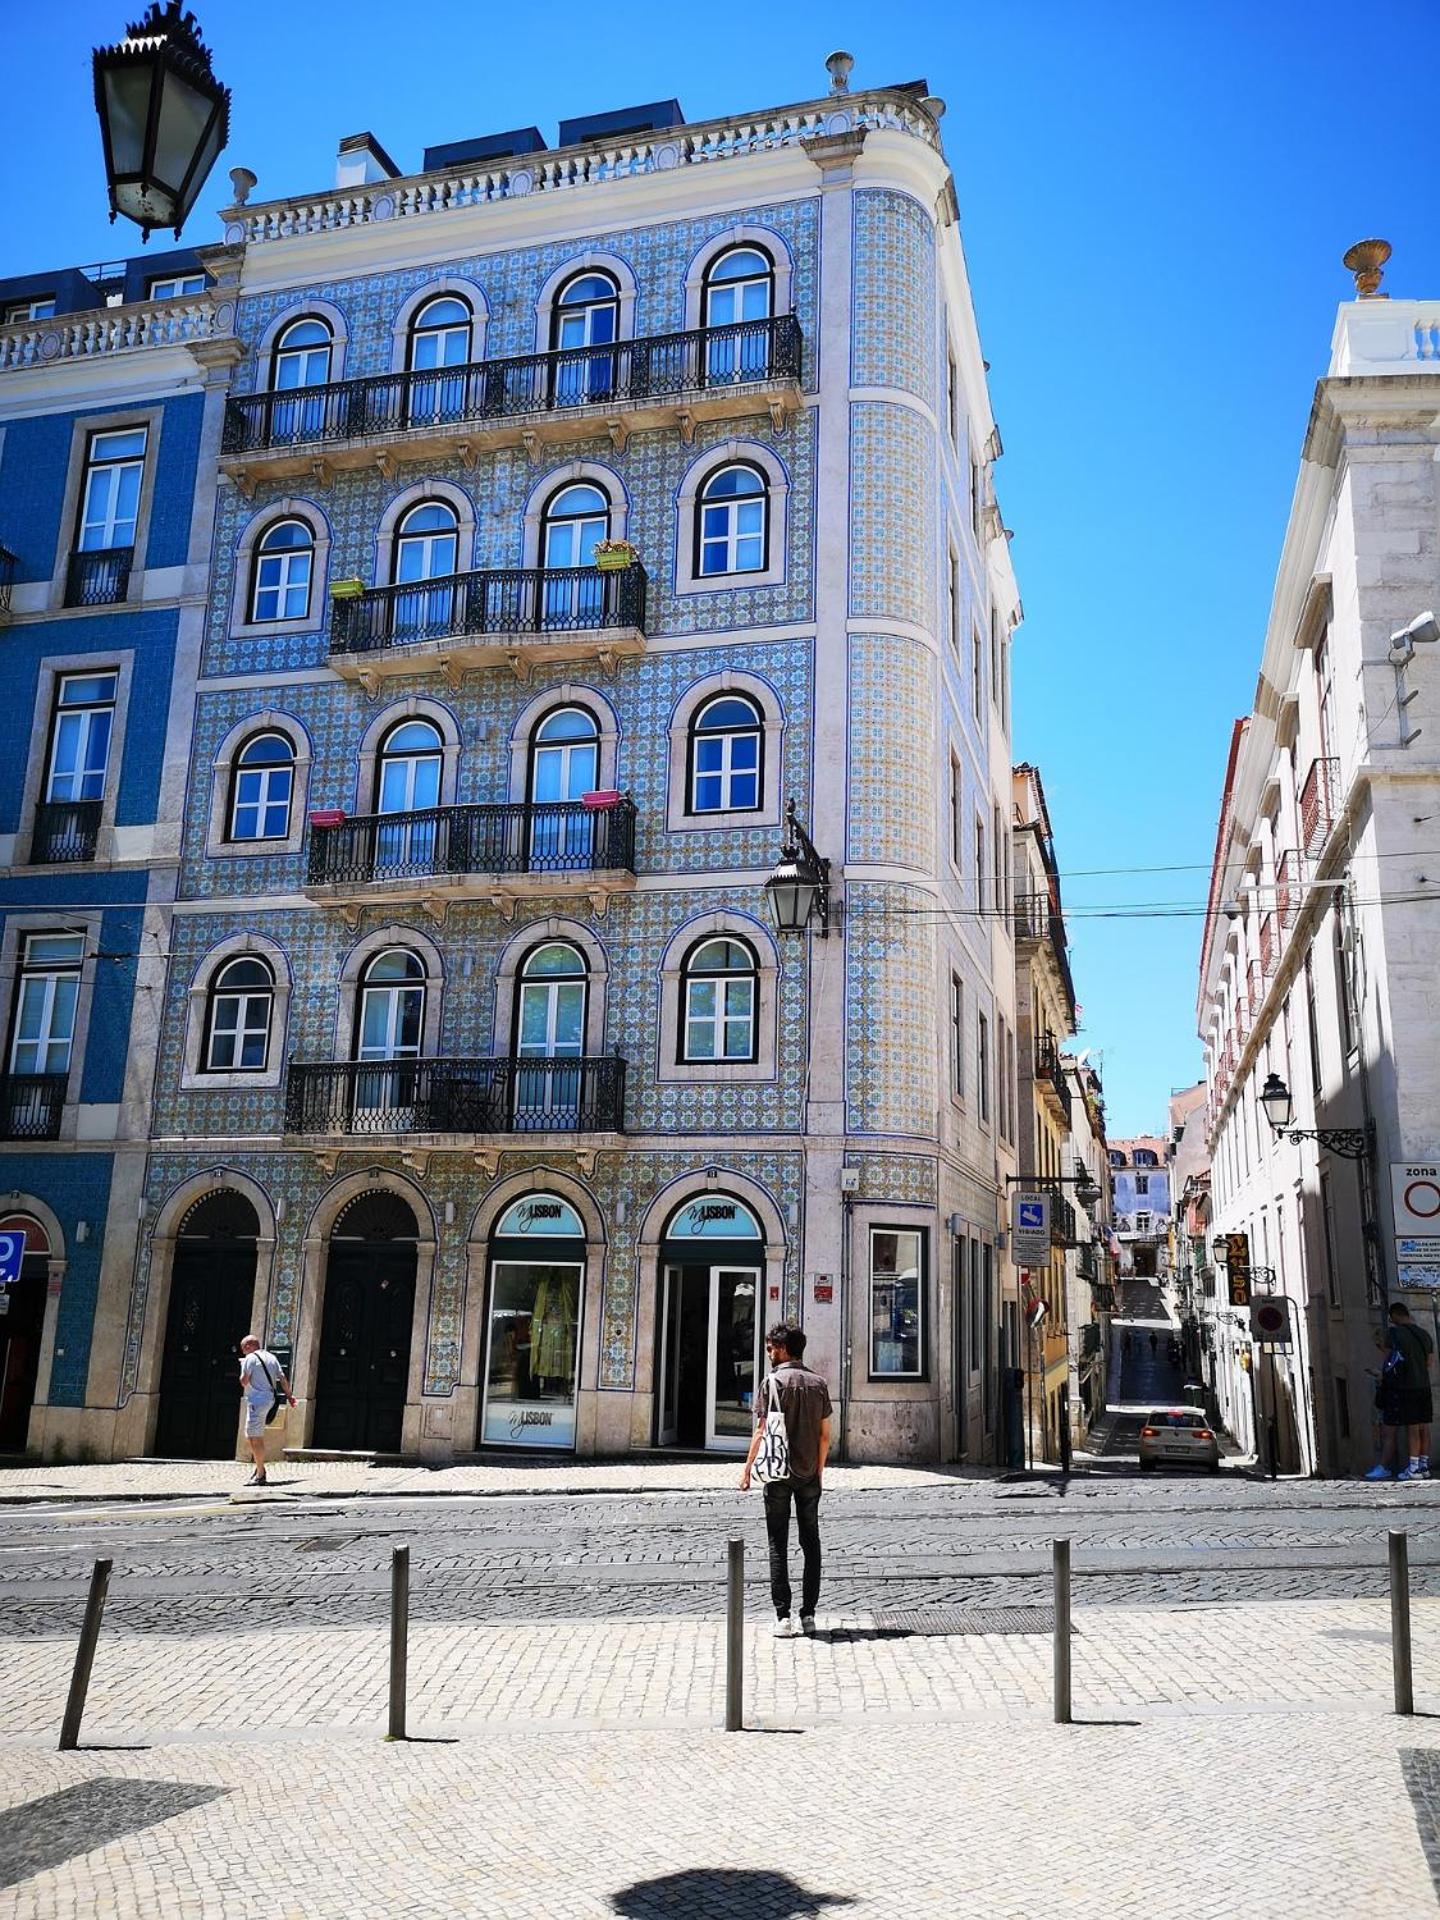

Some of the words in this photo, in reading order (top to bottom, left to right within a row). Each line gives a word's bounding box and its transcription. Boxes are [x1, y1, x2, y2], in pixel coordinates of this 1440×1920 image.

[1406, 1168, 1437, 1177] zona
[530, 1204, 562, 1218] LISBON
[701, 1205, 736, 1220] LISBON
[520, 1410, 553, 1426] LISBON
